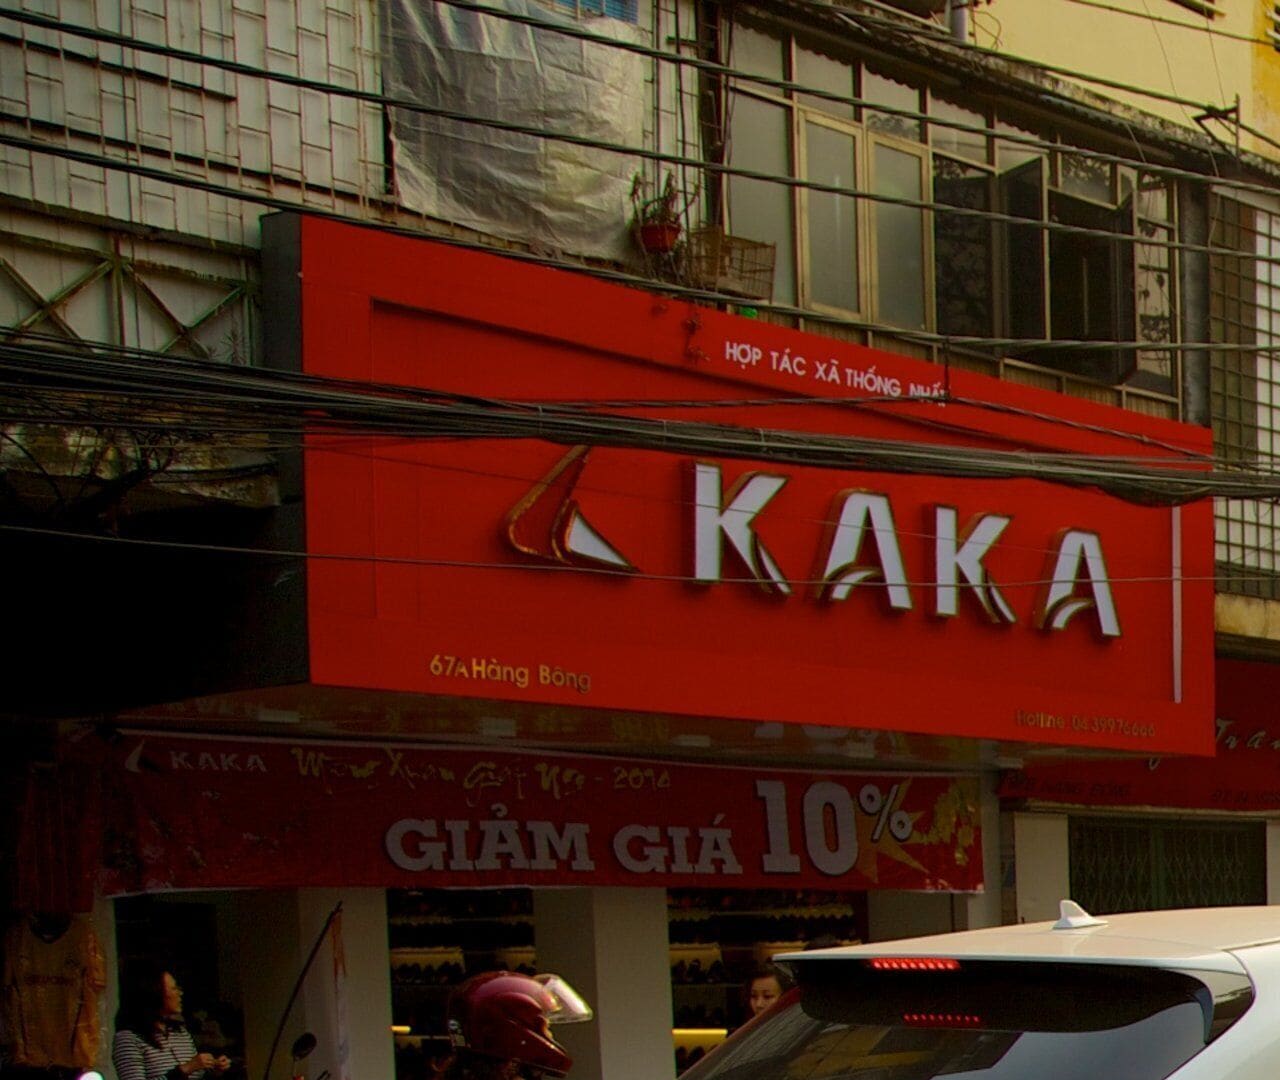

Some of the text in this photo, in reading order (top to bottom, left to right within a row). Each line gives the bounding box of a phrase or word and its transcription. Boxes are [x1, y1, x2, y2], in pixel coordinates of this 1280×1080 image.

[725, 341, 762, 369] HỢP
[770, 348, 806, 376] TÁC
[814, 359, 840, 384] XÃ
[845, 365, 901, 397] THỐNG
[692, 460, 1123, 638] KAKA
[429, 654, 592, 694] 67A Hàng Bông
[168, 751, 267, 773] KAKA
[385, 778, 914, 876] GIẢM GIÁ 10%
